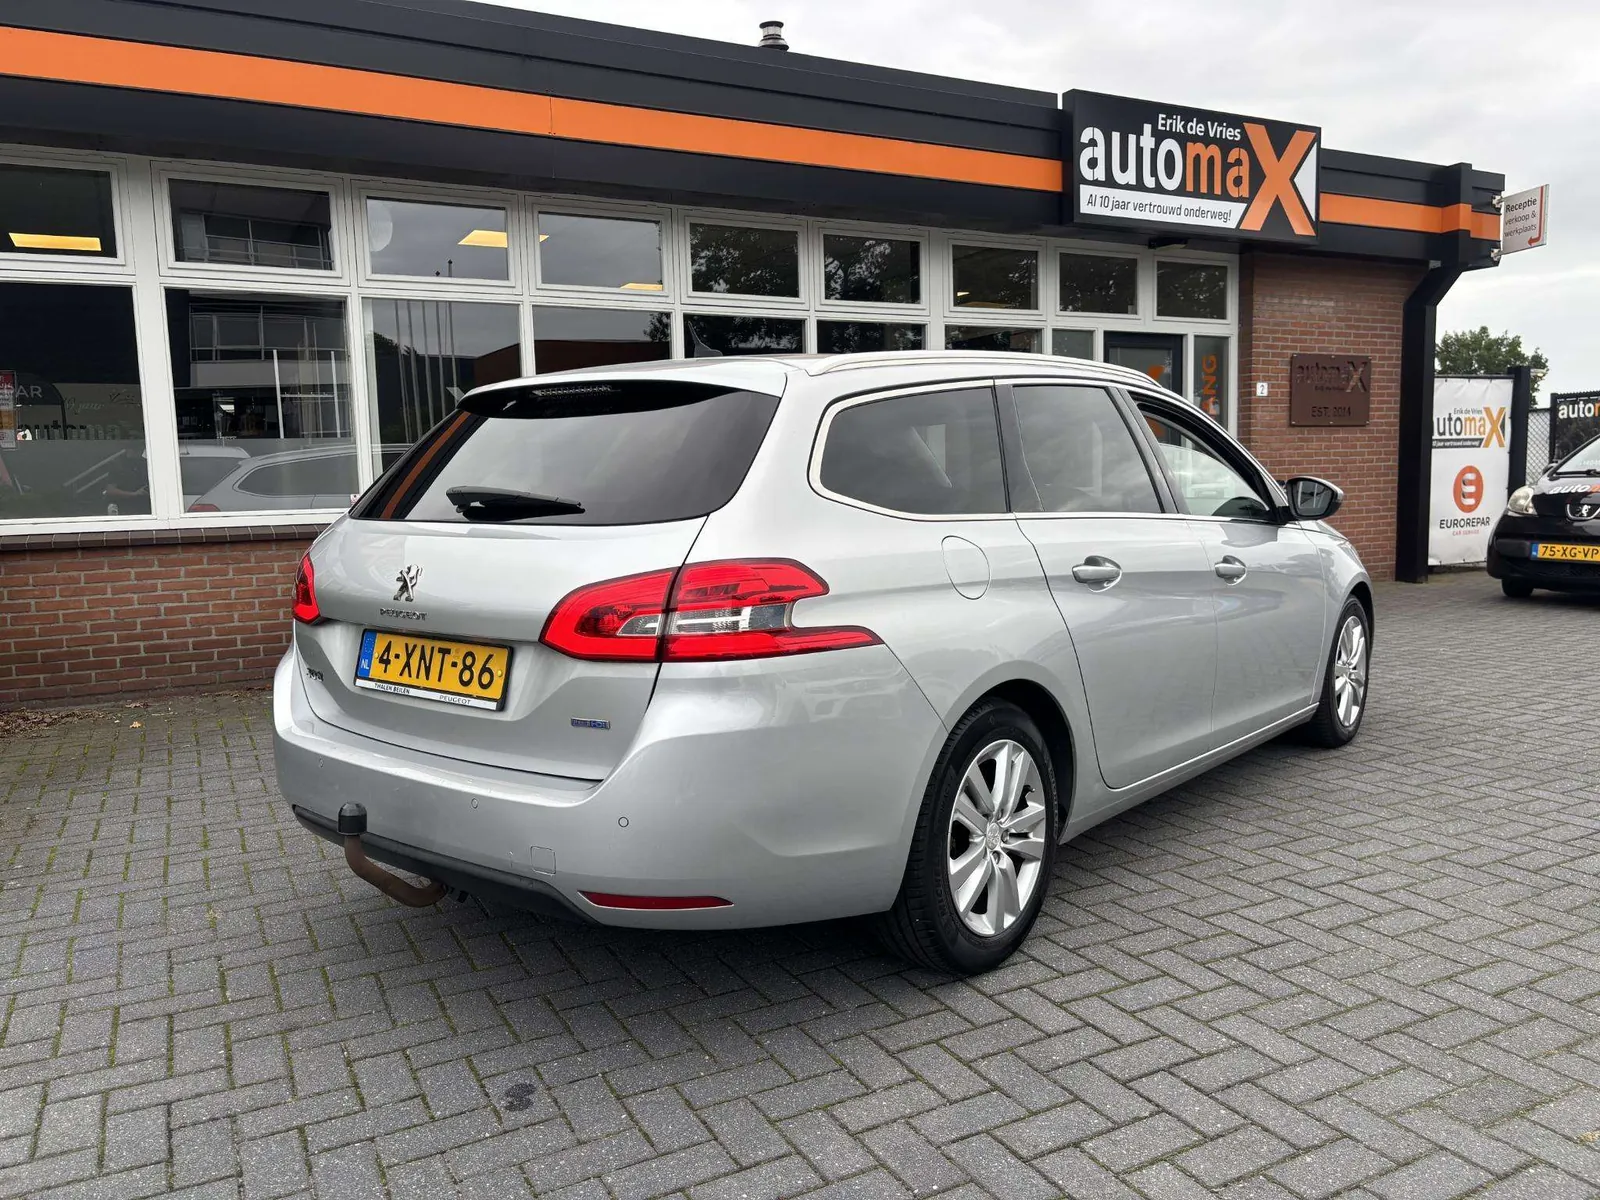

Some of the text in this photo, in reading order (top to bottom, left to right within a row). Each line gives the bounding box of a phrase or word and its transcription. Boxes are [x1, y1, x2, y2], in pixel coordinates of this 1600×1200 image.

[1158, 113, 1241, 141] Erik de Vries
[1079, 121, 1317, 237] automaX
[1099, 195, 1110, 208] 10
[1110, 198, 1130, 212] jaar
[1132, 201, 1182, 217] vertrouwd
[1183, 206, 1232, 222] onderweg!
[1505, 198, 1538, 213] Receptie
[1505, 210, 1537, 225] verkoop &
[1504, 224, 1537, 237] werkplaats
[1259, 384, 1266, 395] 2
[1434, 406, 1506, 448] utomaX
[1439, 516, 1491, 530] EUROREPAR
[1541, 545, 1599, 559] 75-XG-VP
[380, 608, 428, 621] PEUGEOT
[360, 659, 370, 671] NL
[378, 640, 495, 690] 4-XNT-86
[439, 694, 472, 705] PEUGEOT
